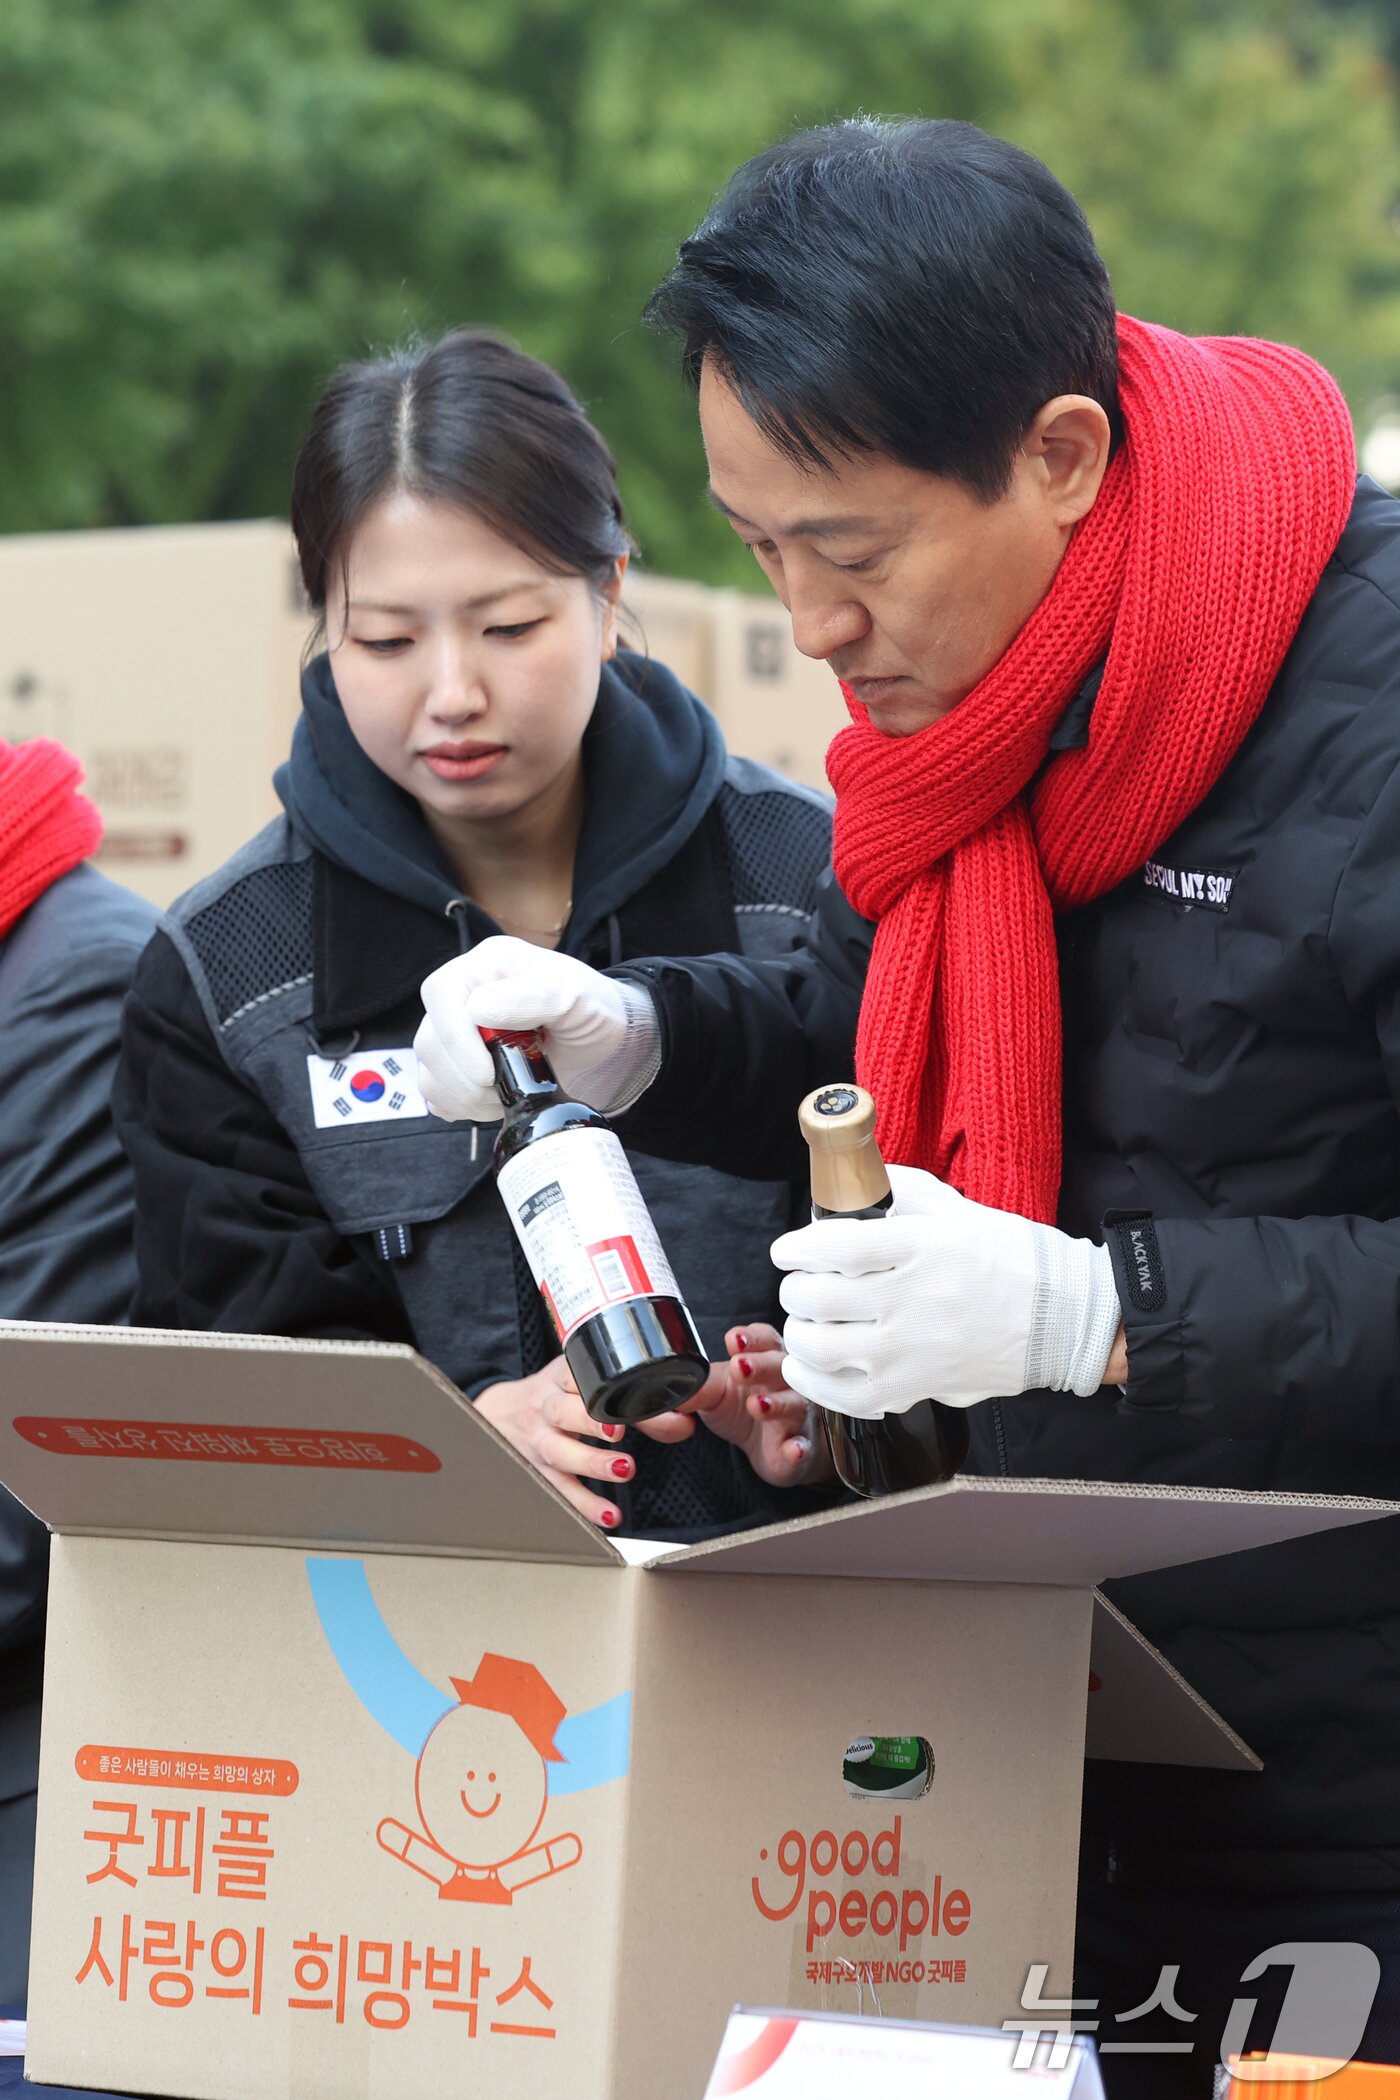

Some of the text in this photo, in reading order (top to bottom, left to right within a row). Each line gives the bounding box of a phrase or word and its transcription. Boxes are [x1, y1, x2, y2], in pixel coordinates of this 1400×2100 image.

[60, 1426, 389, 1462] 희망으로 채워진 상자를
[98, 1755, 277, 1787] 좋은 사람들이 채우는 희망의 상자
[83, 1799, 276, 1901] 굿피플
[752, 1815, 902, 1921] good
[806, 1874, 971, 1952] people
[75, 1913, 557, 2039] 사랑의 희망박스
[928, 1959, 967, 1984] 굿피플
